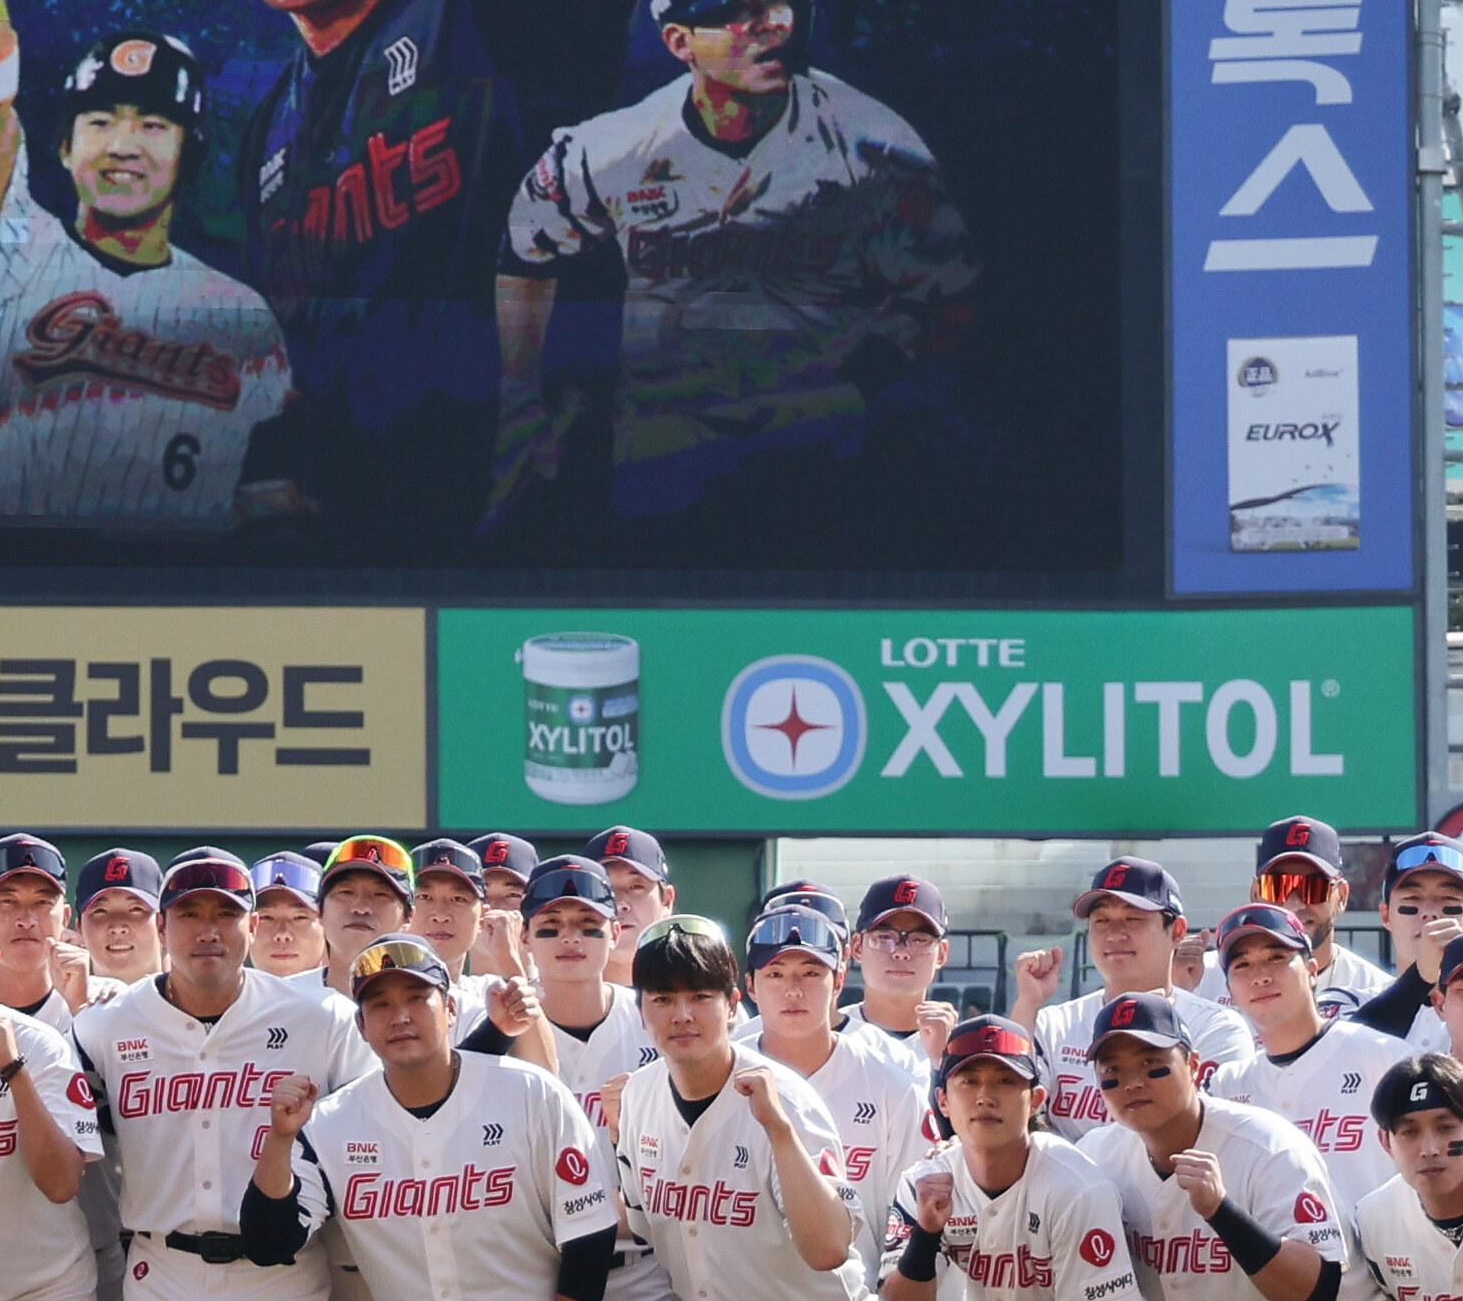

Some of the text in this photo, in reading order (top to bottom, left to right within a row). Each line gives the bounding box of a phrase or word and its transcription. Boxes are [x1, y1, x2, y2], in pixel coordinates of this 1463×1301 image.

[23, 292, 241, 399] Giants
[1246, 422, 1340, 446] EUROX
[162, 434, 200, 491] 6
[881, 637, 1026, 669] LOTTE
[528, 721, 634, 755] XYLITOL
[117, 1038, 148, 1052] BNK
[347, 1142, 379, 1154] BNK
[343, 1164, 518, 1220] Giants
[639, 1167, 760, 1227] Giants
[1133, 1227, 1231, 1274] iants
[1385, 1255, 1411, 1269] BNK
